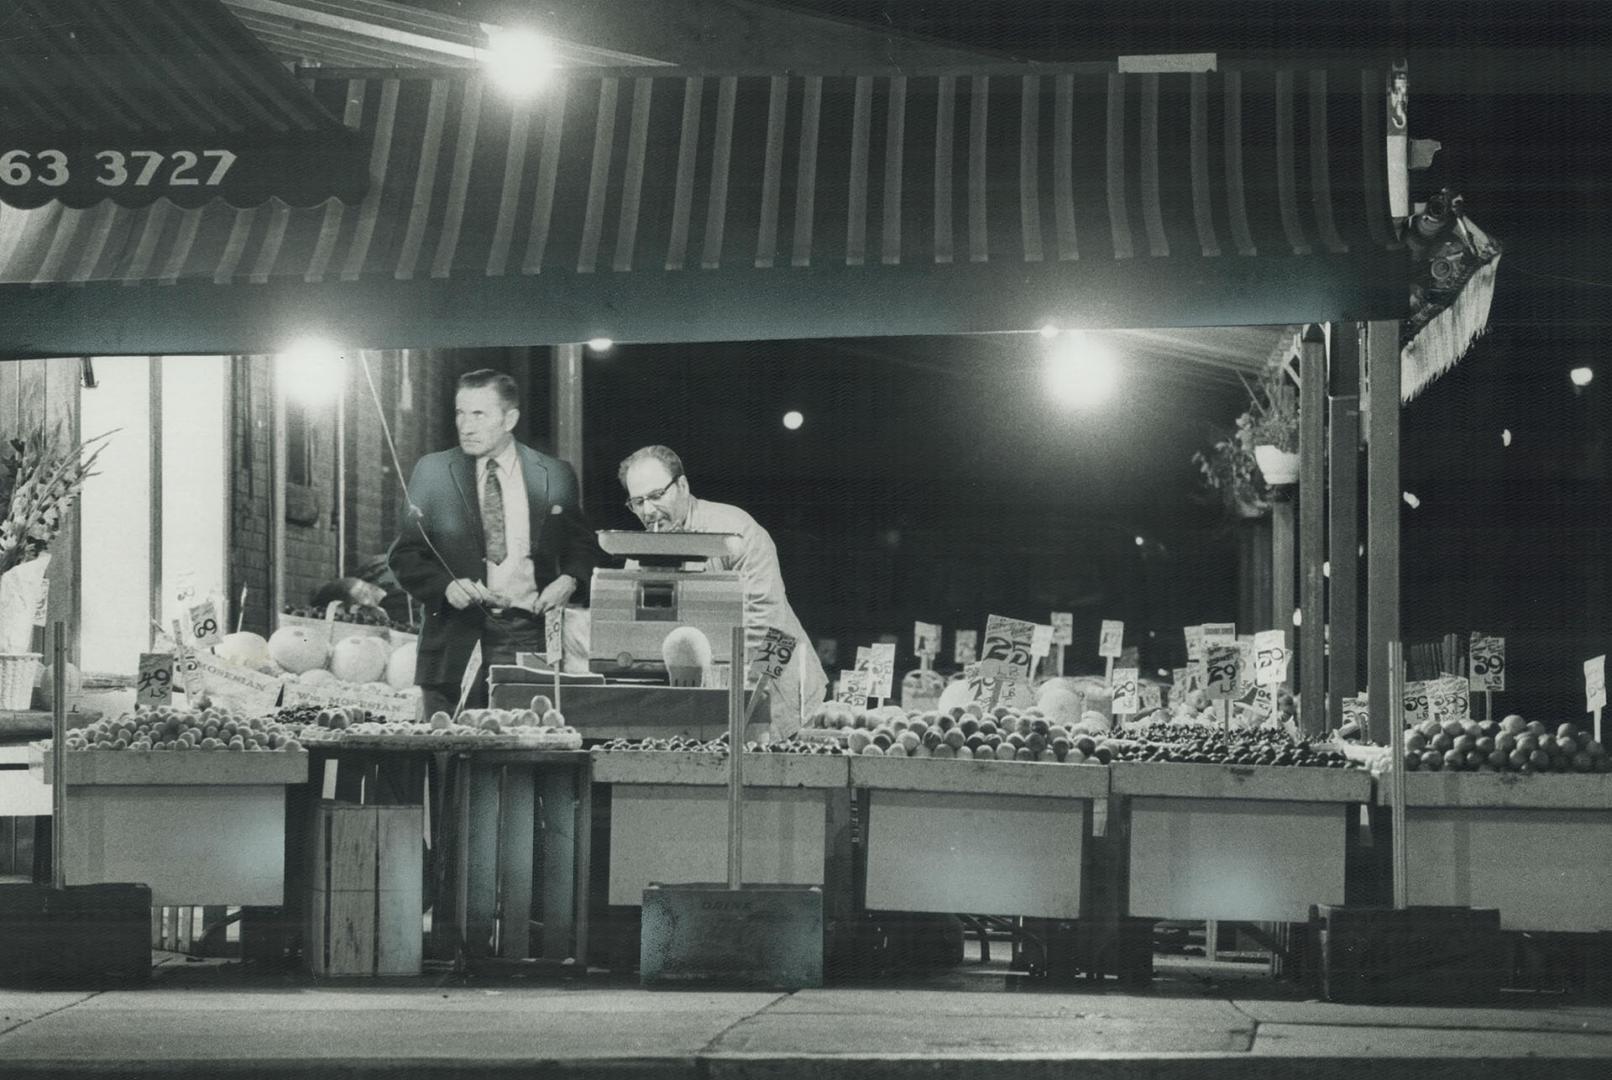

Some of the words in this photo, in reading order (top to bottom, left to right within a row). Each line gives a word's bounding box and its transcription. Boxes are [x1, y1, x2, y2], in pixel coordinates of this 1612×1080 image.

[0, 150, 69, 186] 63
[96, 150, 237, 186] 3727
[753, 642, 791, 665] 49
[984, 636, 1031, 665] 25
[1207, 665, 1236, 686] 29
[1473, 655, 1504, 674] 39
[138, 668, 170, 692] 49
